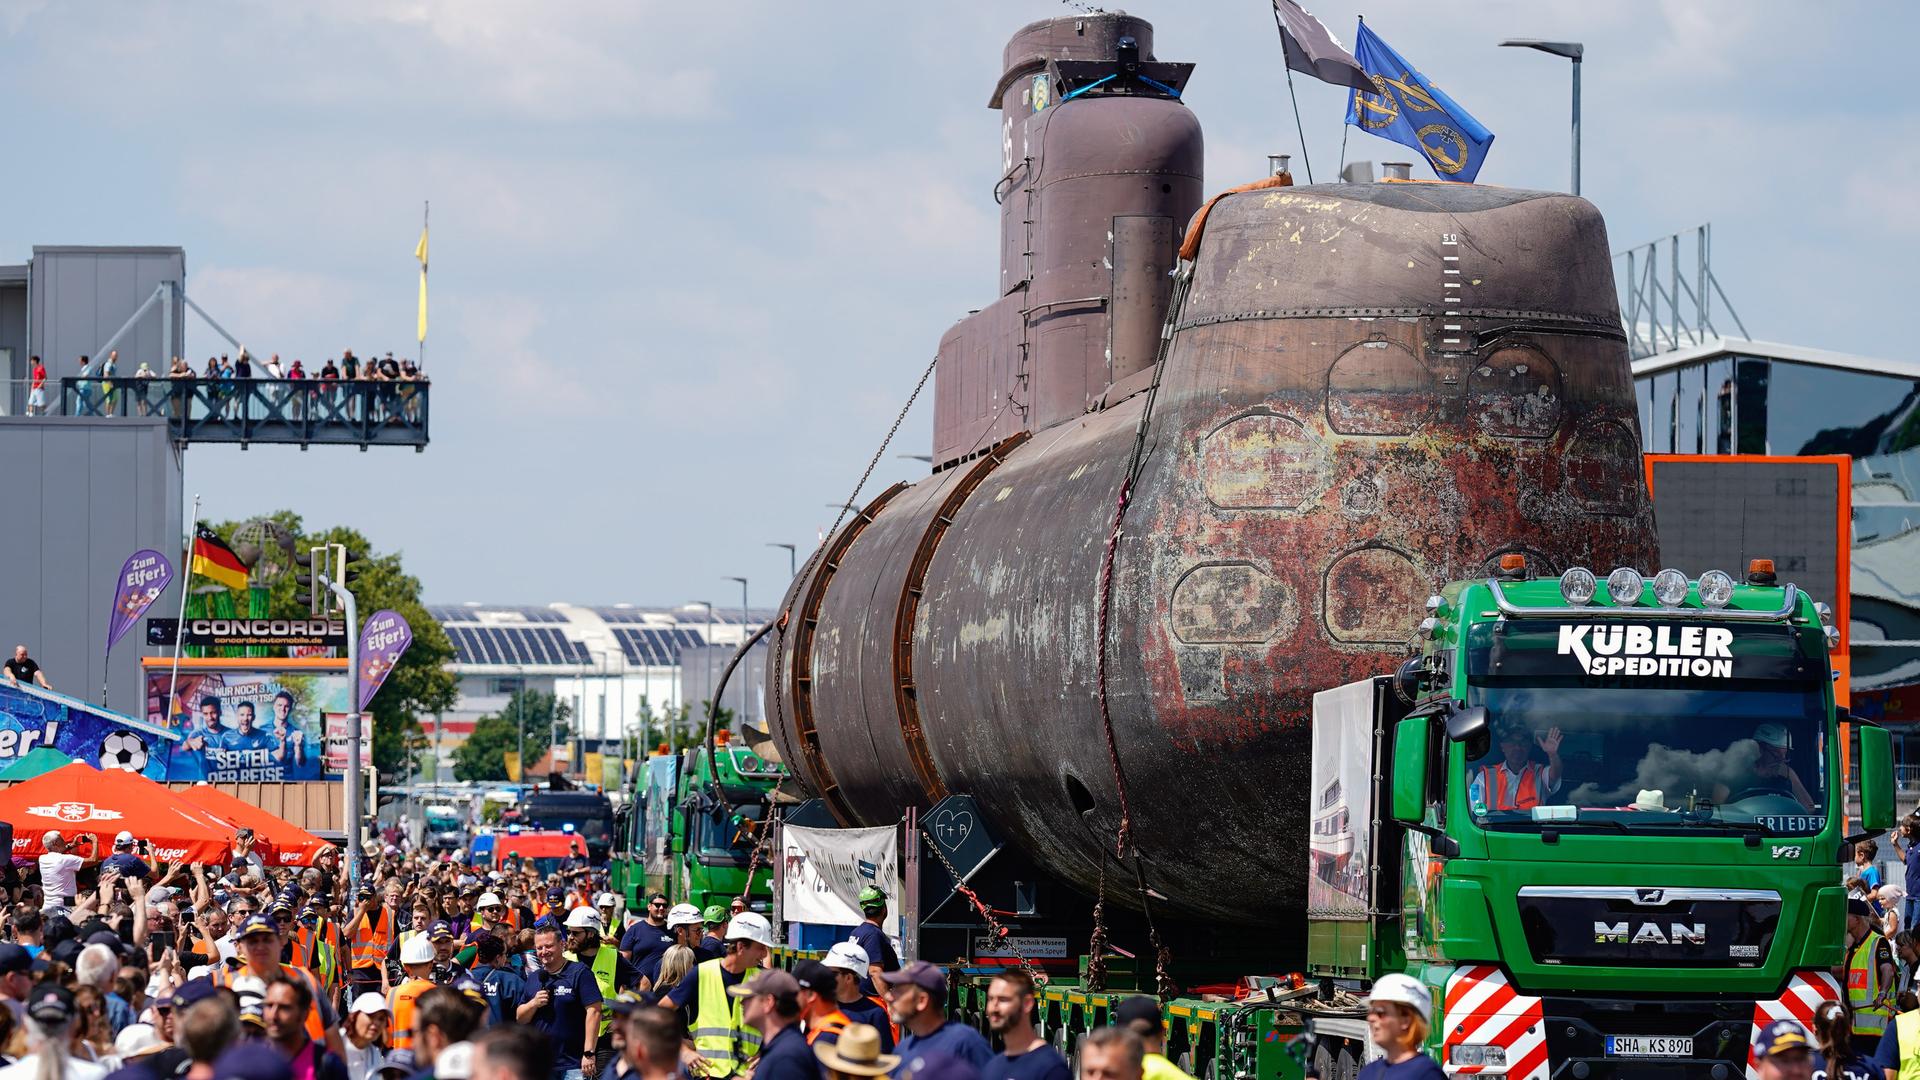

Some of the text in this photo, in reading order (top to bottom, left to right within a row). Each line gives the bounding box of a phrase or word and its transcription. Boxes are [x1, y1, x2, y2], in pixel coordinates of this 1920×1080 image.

[1443, 233, 1457, 241] 50
[132, 556, 156, 570] Zum
[126, 563, 166, 587] Elfer!
[192, 620, 345, 636] CONCORDE
[372, 618, 395, 634] Zum
[367, 626, 405, 651] Elfer!
[1557, 625, 1734, 675] KÜBLER
[1590, 657, 1733, 678] SPEDITION
[215, 687, 233, 697] NUR
[234, 685, 258, 695] NOCH
[266, 683, 281, 693] KM
[221, 696, 231, 705] ZU
[231, 694, 258, 704] DEINER
[216, 751, 240, 770] SEI
[242, 749, 274, 767] TEIL
[208, 767, 285, 782] DER REISE
[1756, 817, 1826, 831] FRIEDER
[1594, 921, 1706, 945] MAN
[1045, 947, 1066, 955] Speyer
[1615, 1038, 1692, 1054] SHA KS 890
